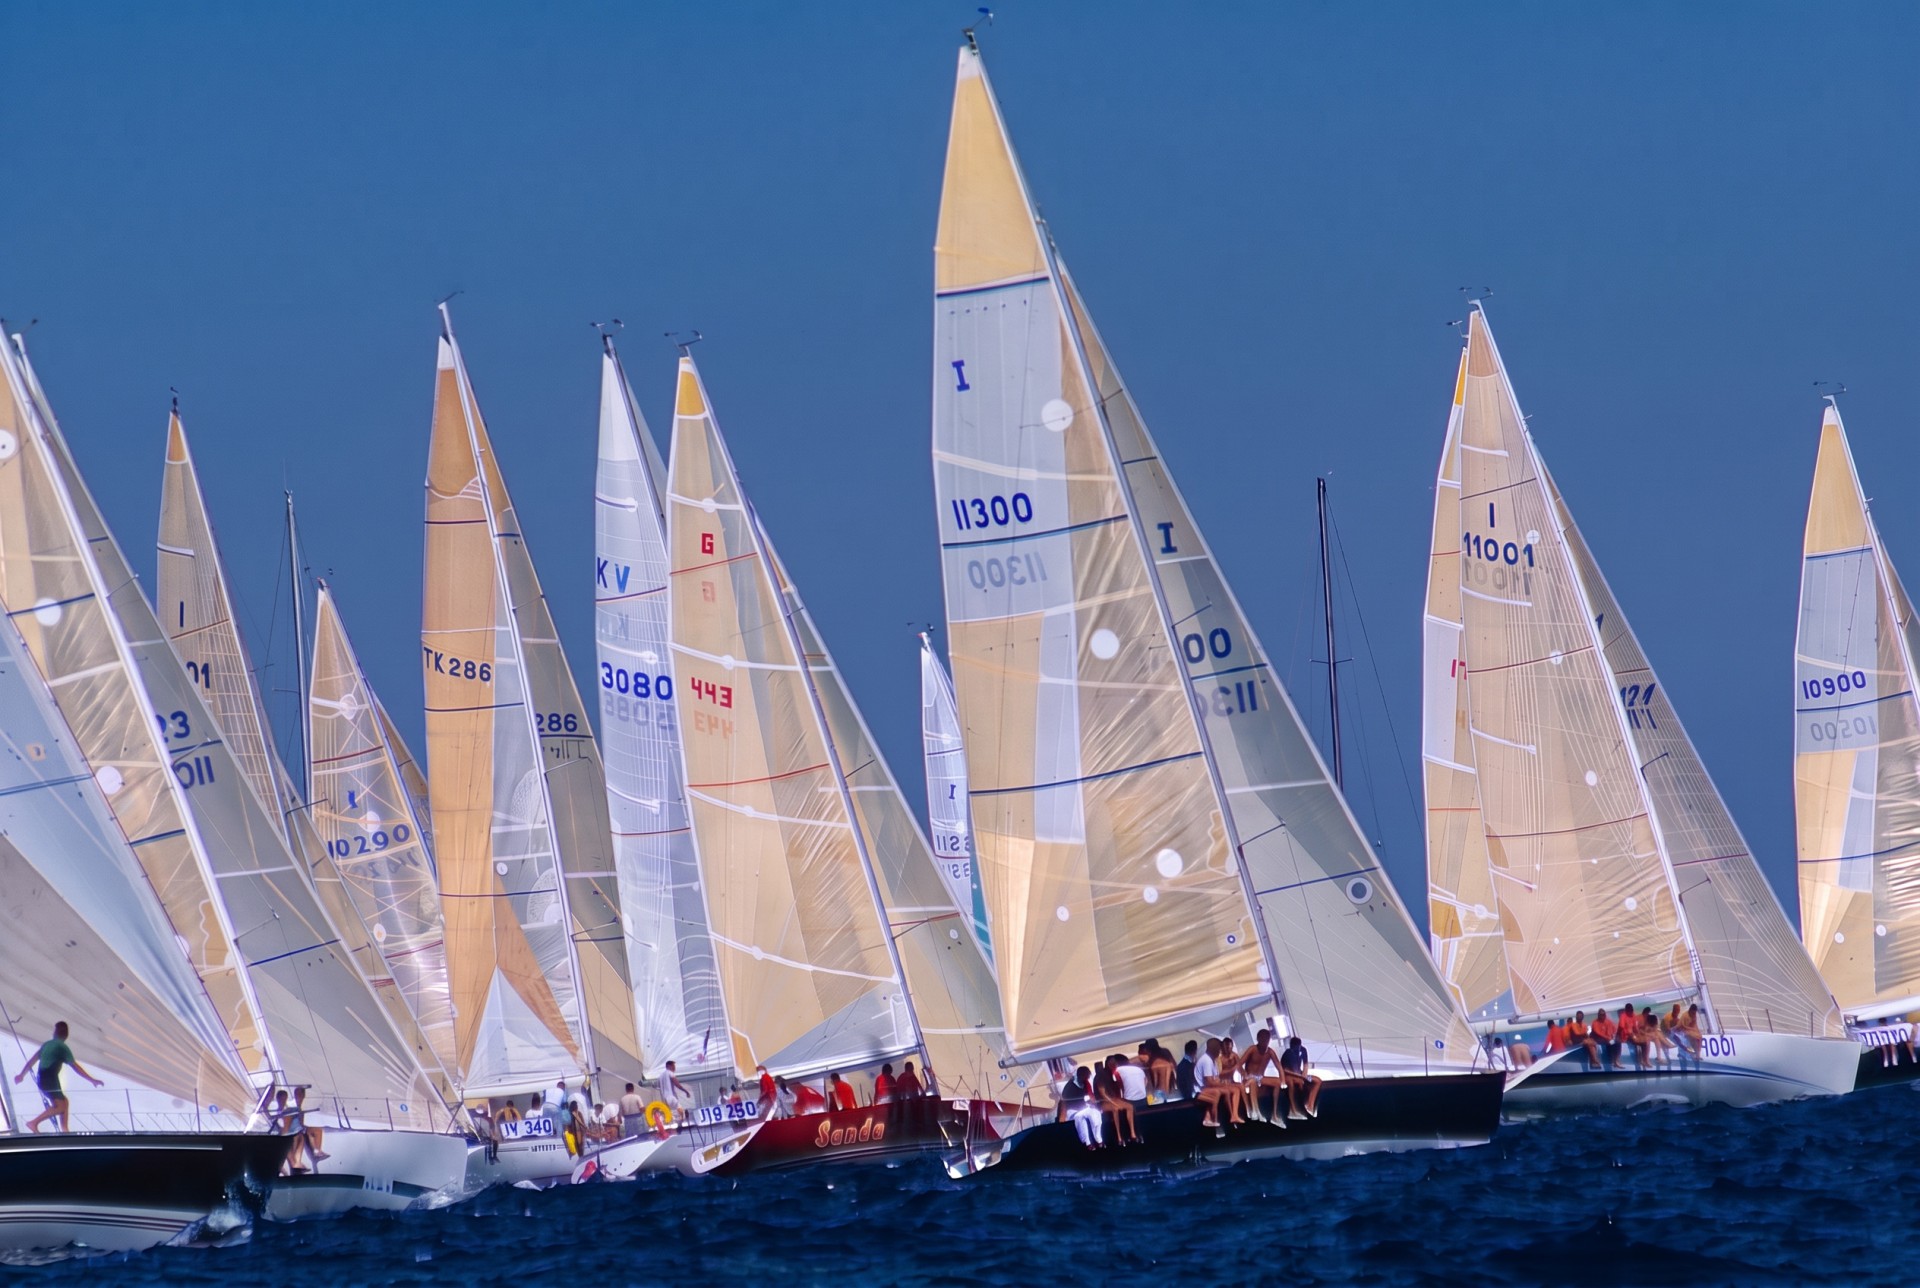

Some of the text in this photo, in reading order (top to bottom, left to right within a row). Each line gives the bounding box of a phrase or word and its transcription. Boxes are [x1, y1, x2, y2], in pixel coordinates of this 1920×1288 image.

[951, 360, 970, 392] I
[951, 492, 1034, 531] 11300
[701, 533, 714, 556] G
[1156, 521, 1178, 555] I
[1463, 531, 1535, 568] 11001
[601, 661, 674, 701] 3080
[691, 676, 733, 709] 443
[1802, 670, 1867, 700] 10900
[535, 712, 578, 733] 286
[327, 824, 410, 859] 10290
[525, 1116, 552, 1135] 340
[726, 1101, 757, 1118] 250
[815, 1117, 885, 1148] Sanda
